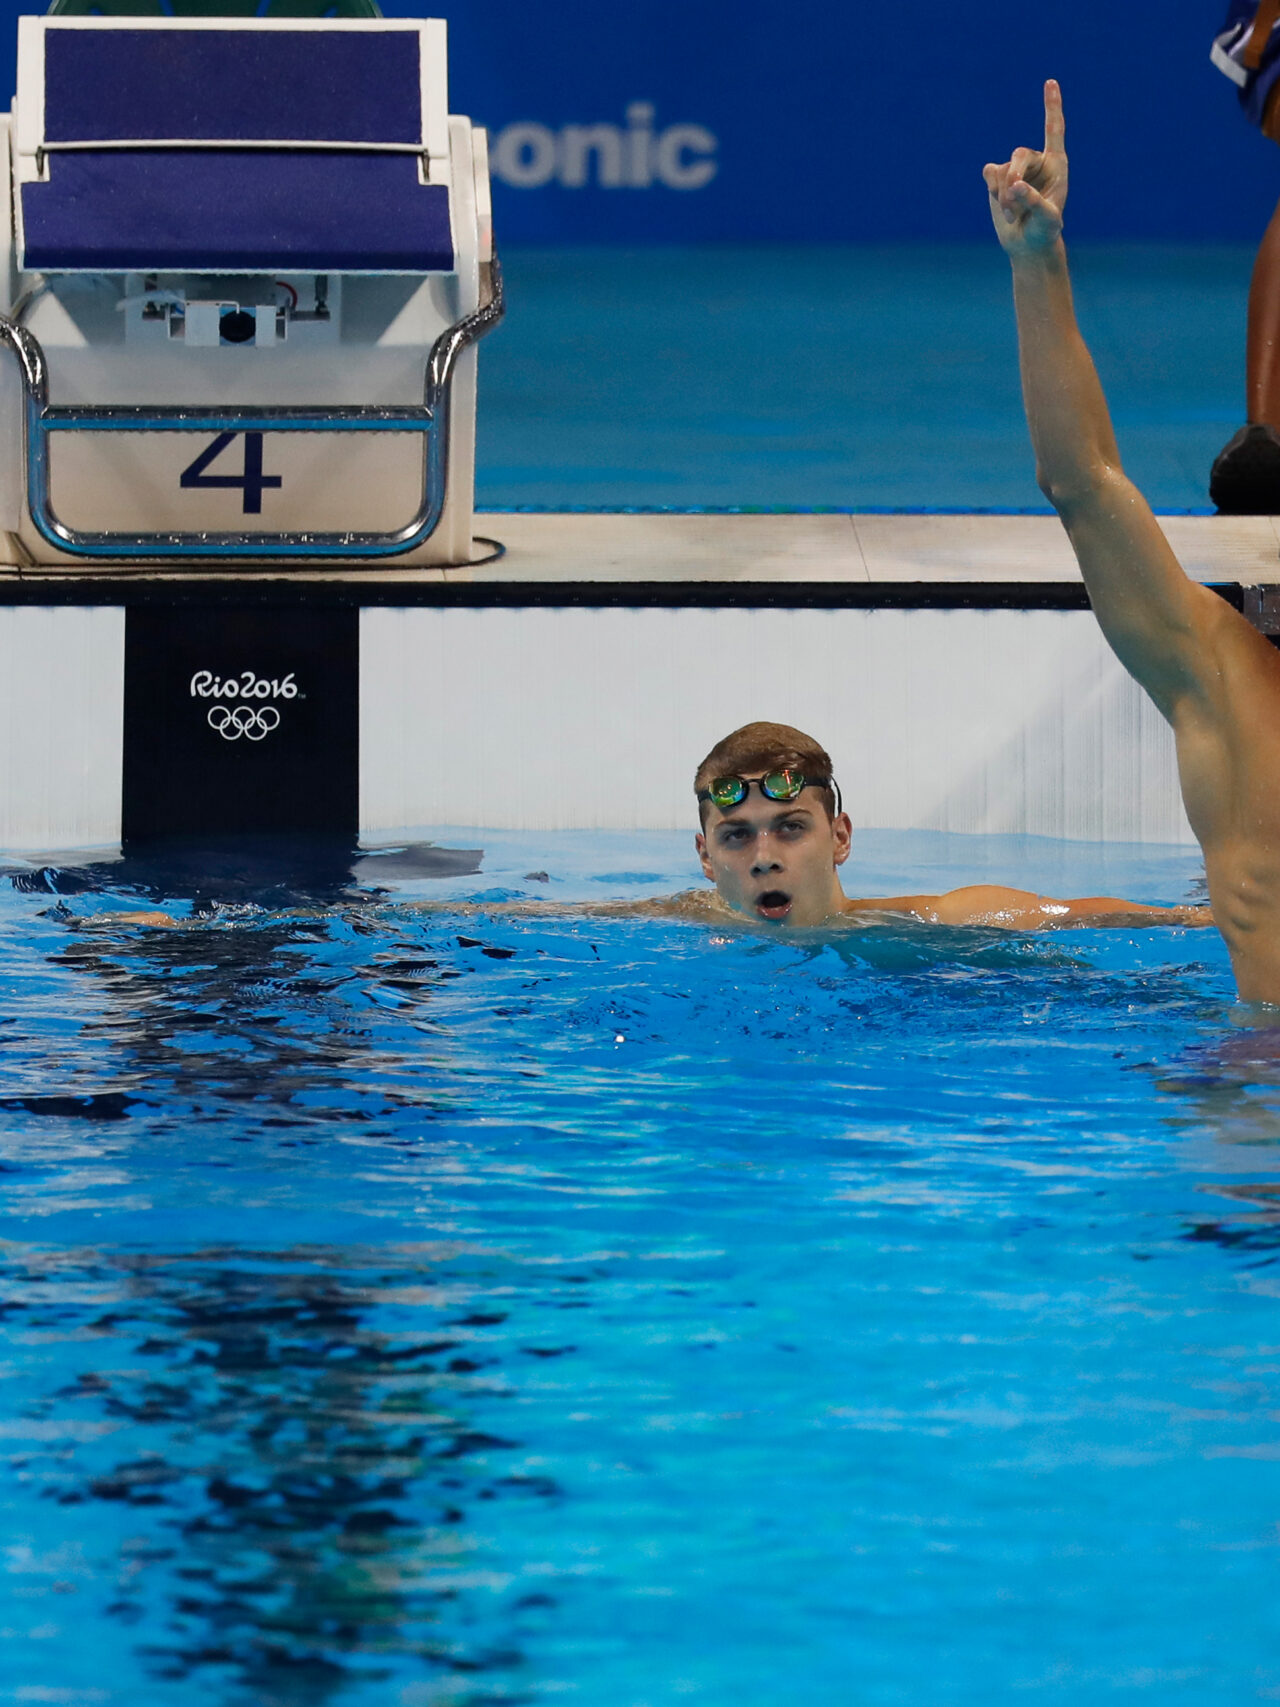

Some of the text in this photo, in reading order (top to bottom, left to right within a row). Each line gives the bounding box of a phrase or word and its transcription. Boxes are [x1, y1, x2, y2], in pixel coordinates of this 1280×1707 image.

[490, 103, 717, 188] onic
[180, 430, 282, 514] 4
[190, 670, 298, 699] Rio2016
